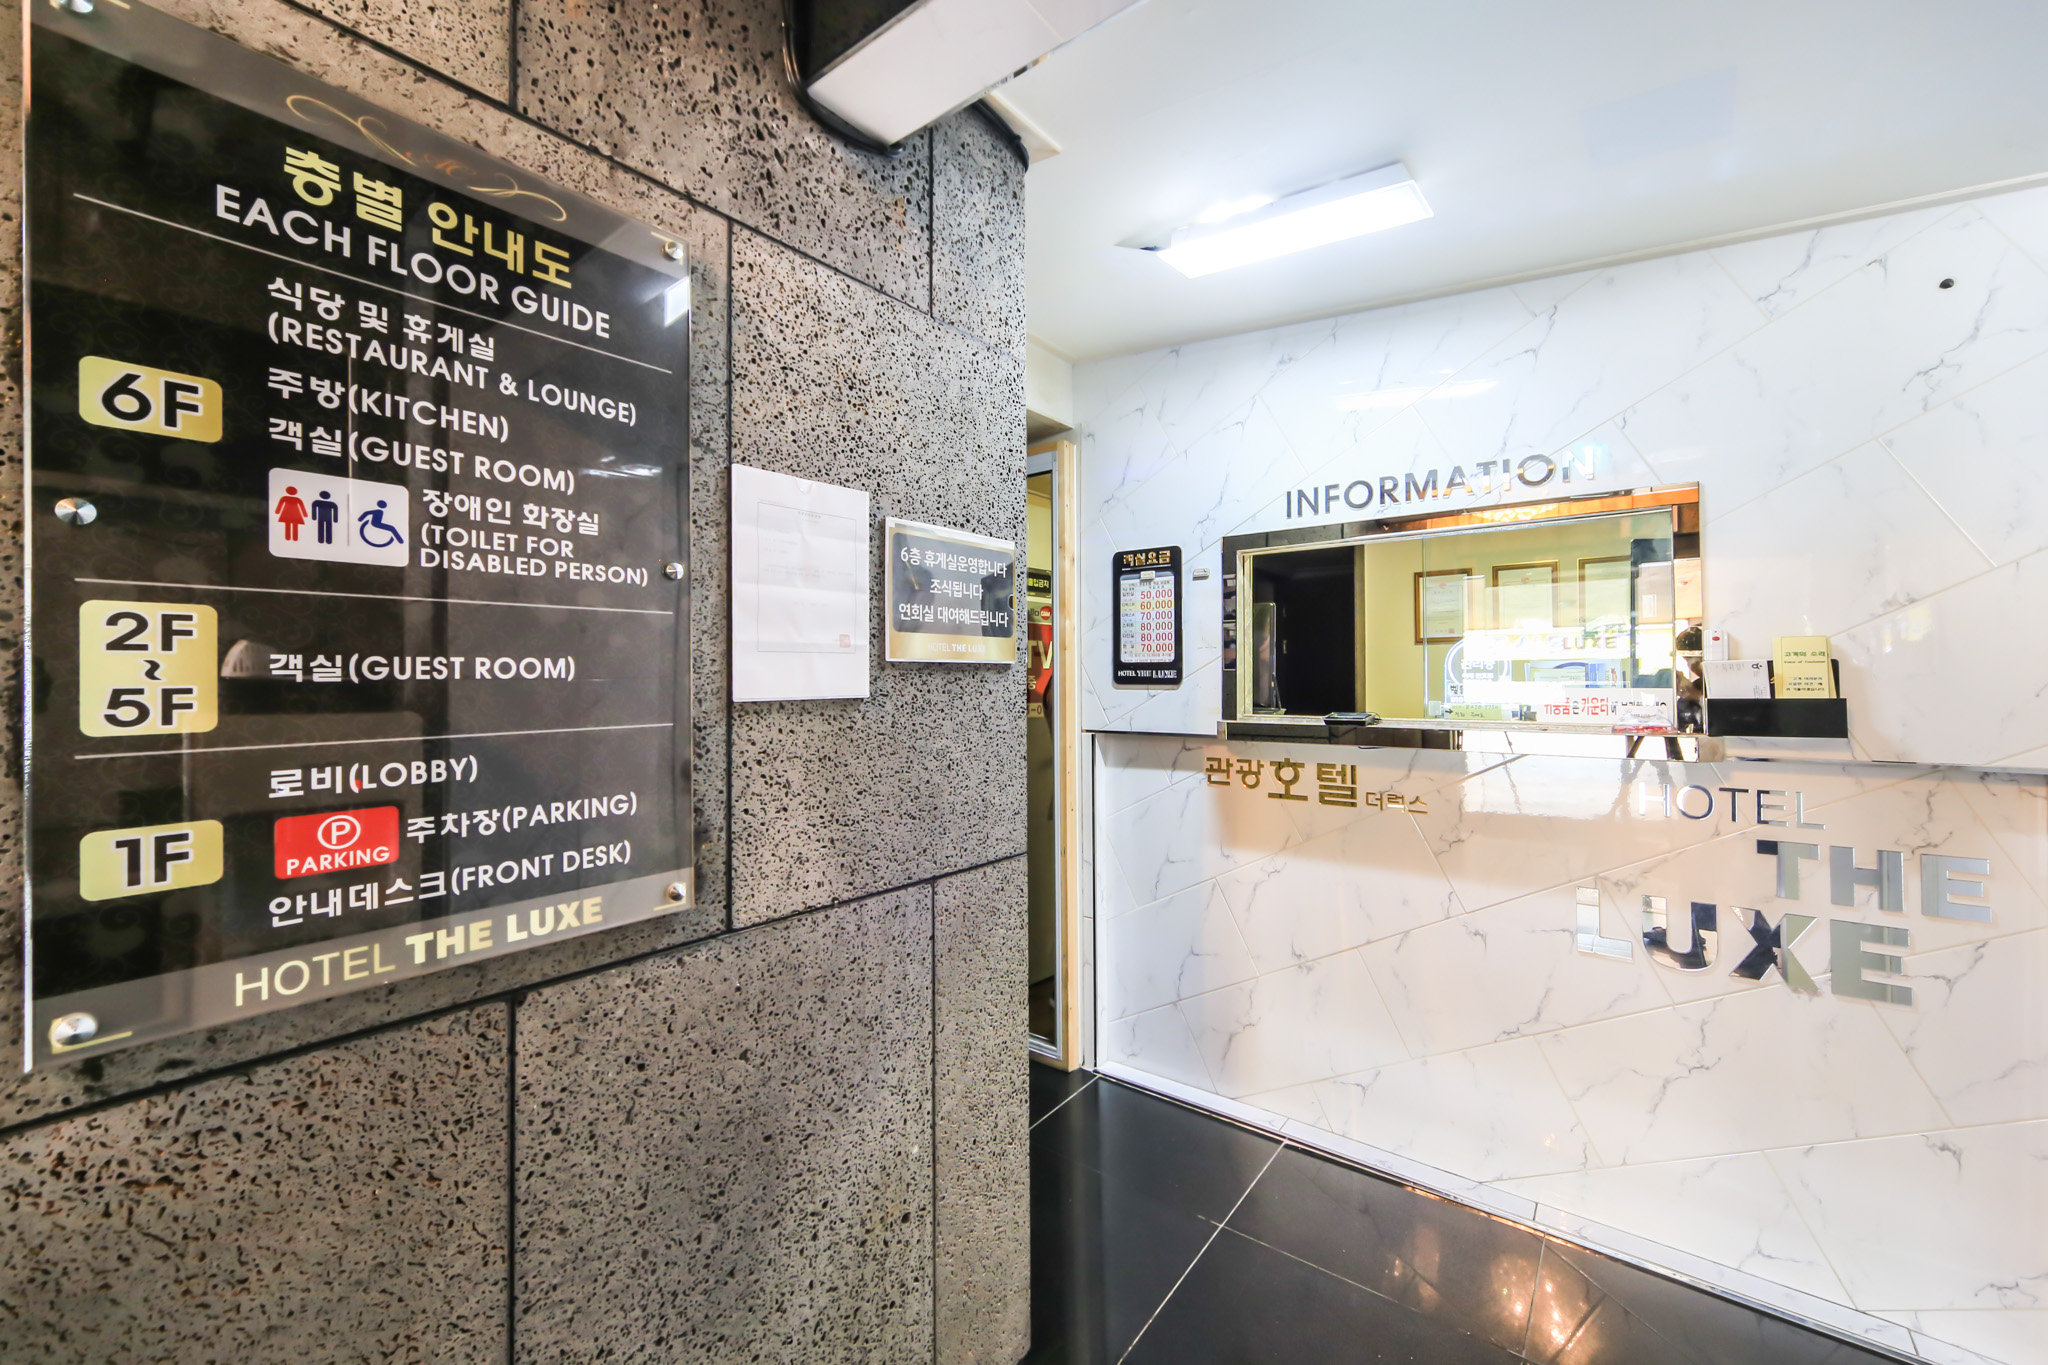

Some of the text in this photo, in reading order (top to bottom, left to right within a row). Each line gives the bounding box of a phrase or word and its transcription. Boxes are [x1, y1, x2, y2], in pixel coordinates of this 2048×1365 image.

[284, 147, 573, 288] 층별 안내도
[217, 184, 610, 339] EACH FLOOR GUIDE
[268, 276, 495, 361] 식당 및 휴게실
[269, 312, 636, 427] (RESTAURANT & LOUNGE)
[100, 372, 204, 431] 6F
[268, 367, 509, 443] 주방(KITCHEN)
[269, 417, 575, 494] 객실(GUEST ROOM)
[1285, 445, 1596, 519] INFORMATION
[422, 489, 600, 535] 장애인 화장실
[422, 524, 574, 558] (TOILET FOR
[1124, 550, 1170, 566] 객실요금
[421, 547, 648, 586] DISABLED PERSON)
[901, 547, 1007, 578] 6층 휴게실운영합니다
[930, 579, 983, 600] 조식됩니다
[1141, 589, 1172, 600] 50,000
[1141, 600, 1172, 610] 60,000
[104, 612, 196, 652] 2F
[899, 603, 1008, 627] 연회실 대여해드립니다
[1141, 610, 1172, 621] 70,000
[1141, 621, 1172, 632] 80,000
[952, 644, 966, 652] THE
[1141, 632, 1172, 642] 80,000
[1141, 643, 1173, 653] 70,000
[269, 652, 575, 683] 객실(GUEST ROOM)
[1153, 670, 1177, 678] LUXE
[104, 687, 196, 727] 5F
[269, 755, 478, 799] 로비(LOBBY)
[1204, 757, 1359, 808] 관광호텔
[406, 792, 637, 842] 주차장(PARKING)
[1640, 783, 1824, 830] HOTEL
[115, 832, 193, 886] 1F
[286, 846, 389, 875] PARKING
[269, 840, 631, 928] 안내데스크(FRONT DESK)
[1756, 839, 1991, 923] THE
[235, 896, 603, 1006] HOTEL THE LUXE
[1576, 887, 1914, 1006] LUXE
